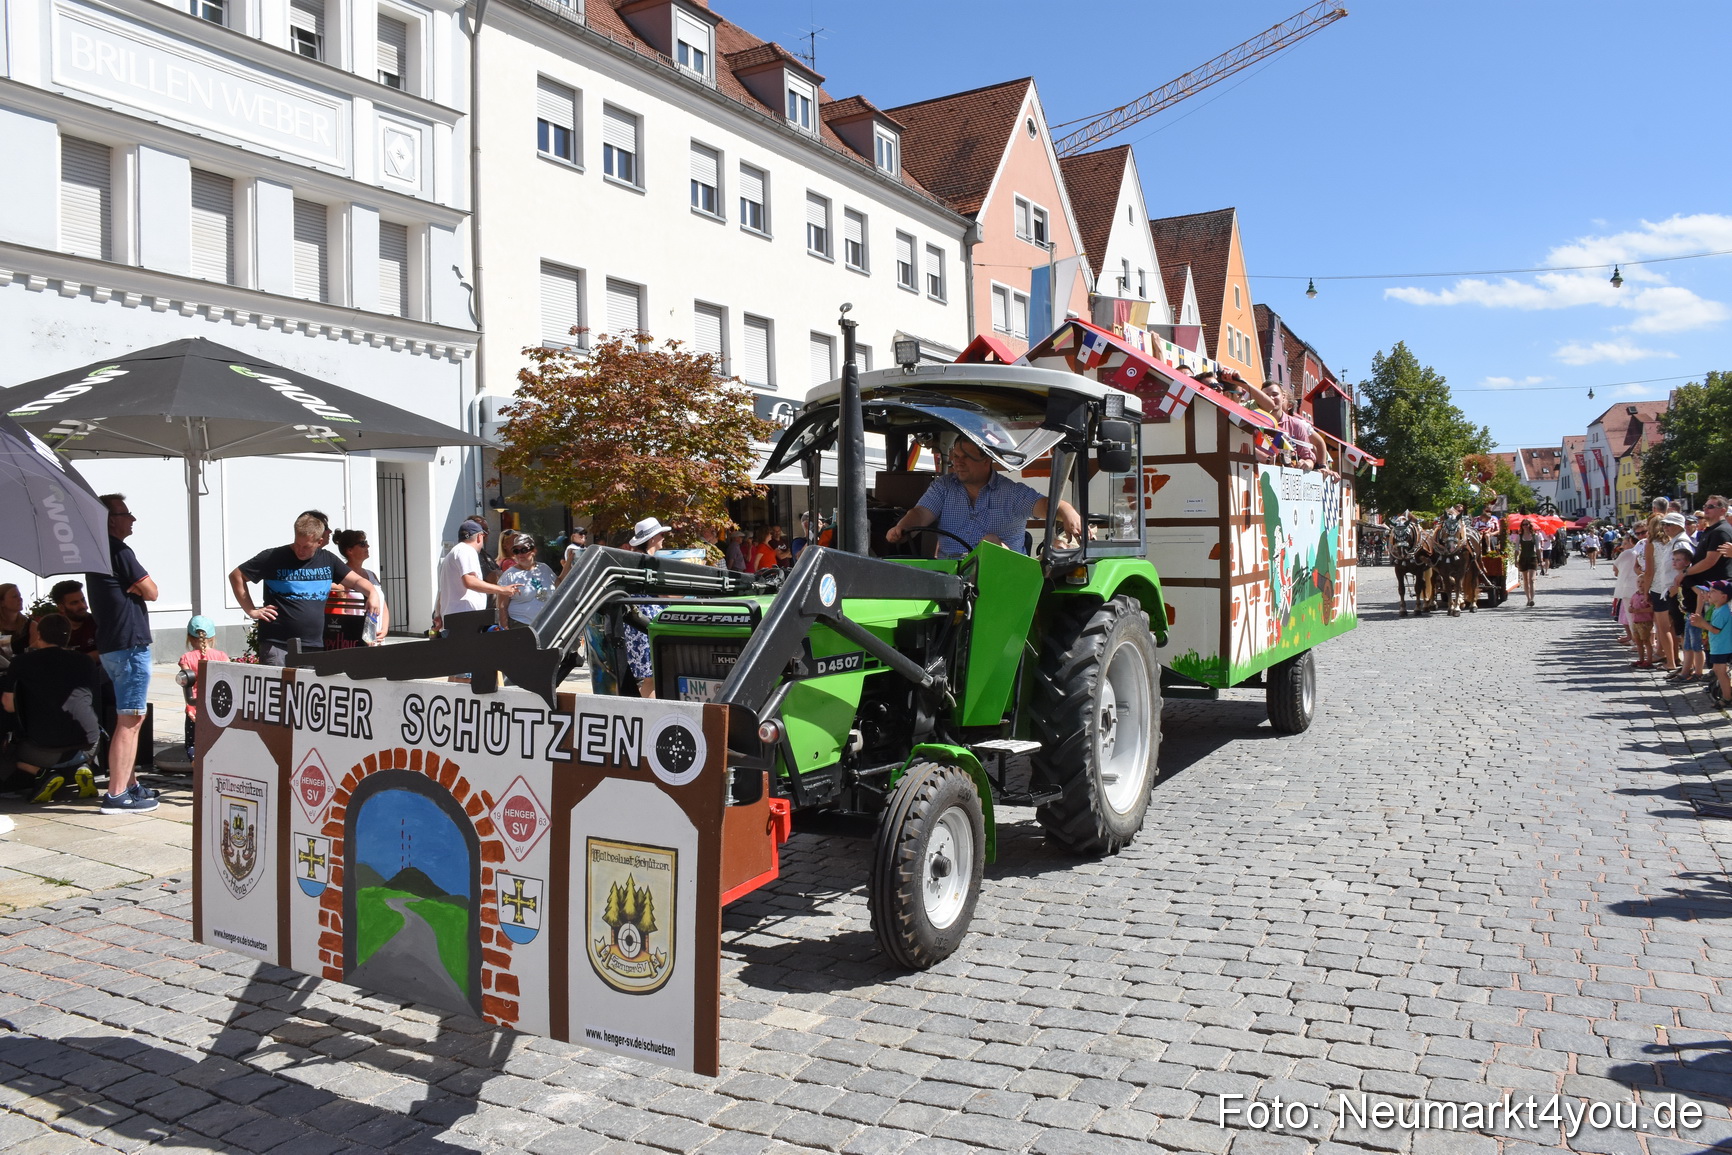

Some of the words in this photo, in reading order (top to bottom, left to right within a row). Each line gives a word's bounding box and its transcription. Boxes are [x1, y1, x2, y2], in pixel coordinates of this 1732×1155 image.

[70, 31, 213, 110] BRILLEN
[220, 82, 331, 147] WEBER
[717, 656, 737, 664] KHD
[817, 661, 826, 674] D
[828, 656, 859, 671] 4507
[689, 680, 707, 696] NM
[242, 675, 374, 740] HENGER
[401, 693, 644, 769] SCHÜTZEN
[301, 776, 325, 788] HENGER
[306, 788, 319, 801] SV
[493, 811, 502, 820] 19
[504, 808, 536, 820] HENGER
[538, 817, 547, 827] 63
[512, 822, 528, 836] SV
[515, 845, 524, 854] eV
[585, 1027, 603, 1040] www.
